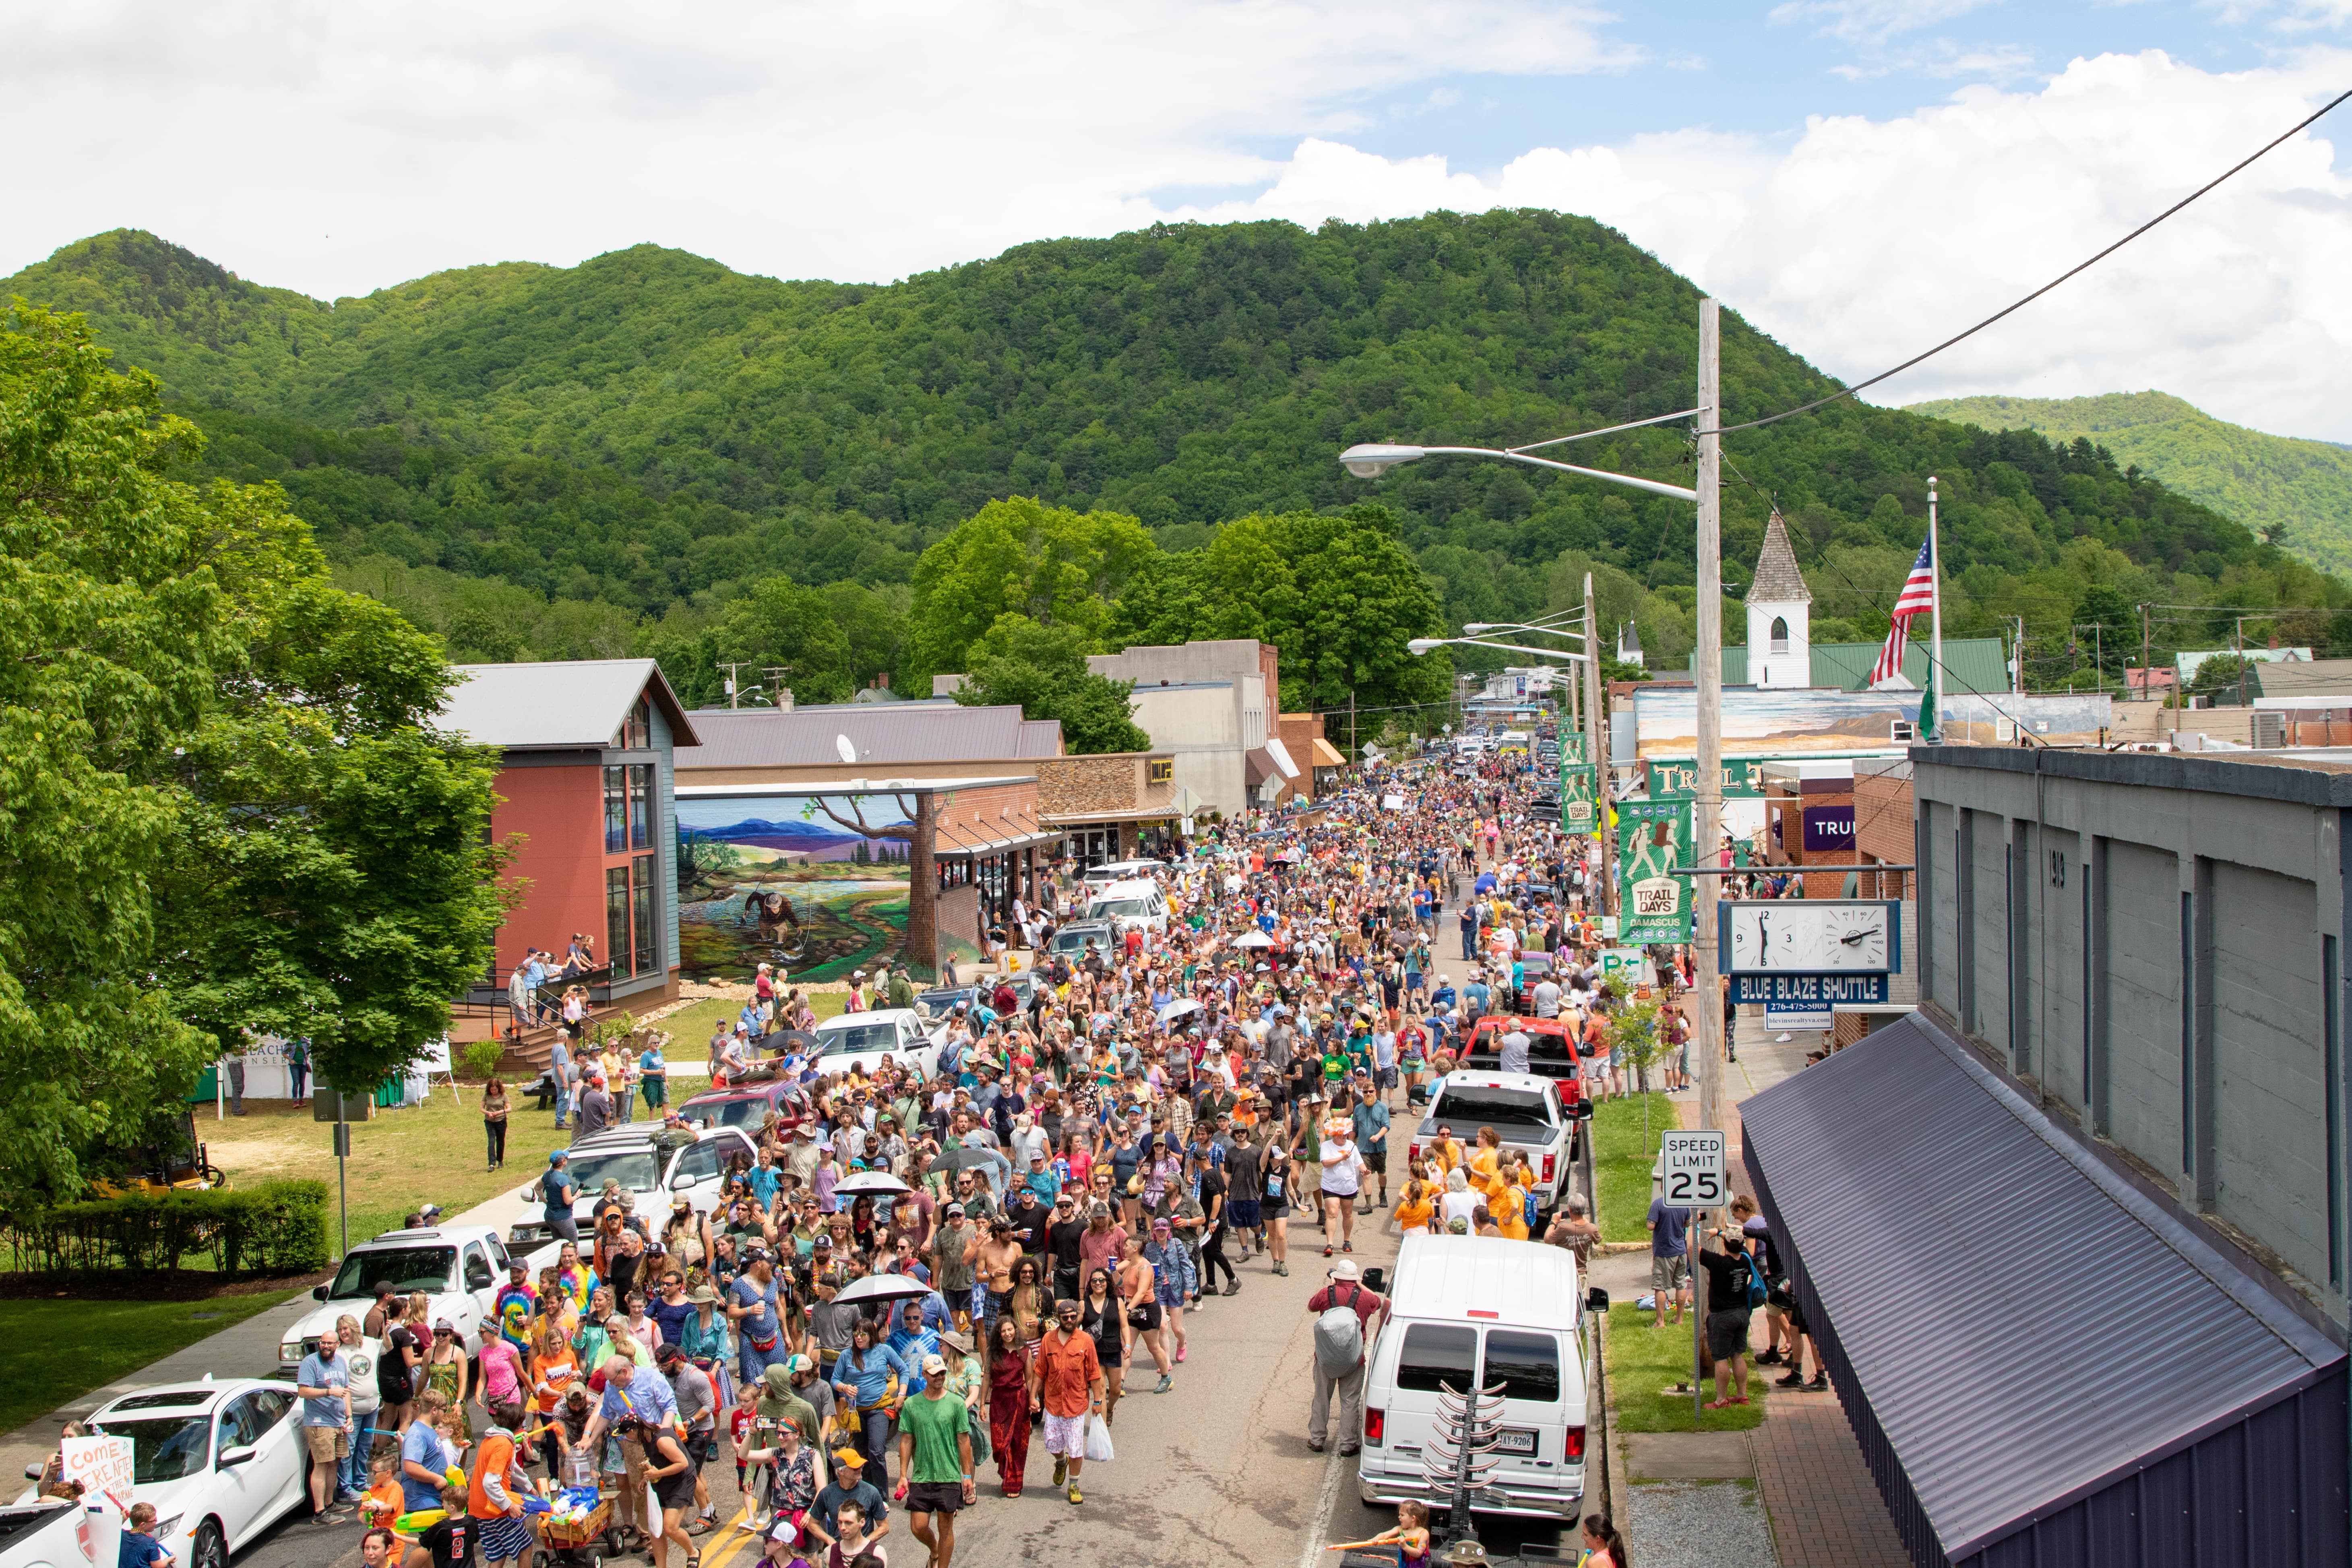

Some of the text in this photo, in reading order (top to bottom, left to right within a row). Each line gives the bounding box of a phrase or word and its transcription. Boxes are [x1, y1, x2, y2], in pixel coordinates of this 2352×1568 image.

[1654, 764, 1741, 793] TRL
[1639, 881, 1673, 889] Appalachian
[1637, 889, 1675, 901] TRAIL
[1639, 901, 1671, 912] DAYS
[1761, 911, 1769, 919] 12
[1630, 918, 1680, 927] DAMASCUS
[1736, 934, 1742, 943] 9
[1786, 934, 1792, 943] 3
[1604, 956, 1622, 975] P
[1741, 977, 1878, 999] BLUE BLAZE SHUTTLE
[1669, 1140, 1719, 1151] SPEED
[1673, 1156, 1715, 1167] LIMIT
[1670, 1172, 1718, 1199] 25
[71, 1442, 120, 1470] COME
[81, 1455, 134, 1493] ERE AFTER
[110, 1478, 124, 1492] THE
[452, 1537, 464, 1558] 2
